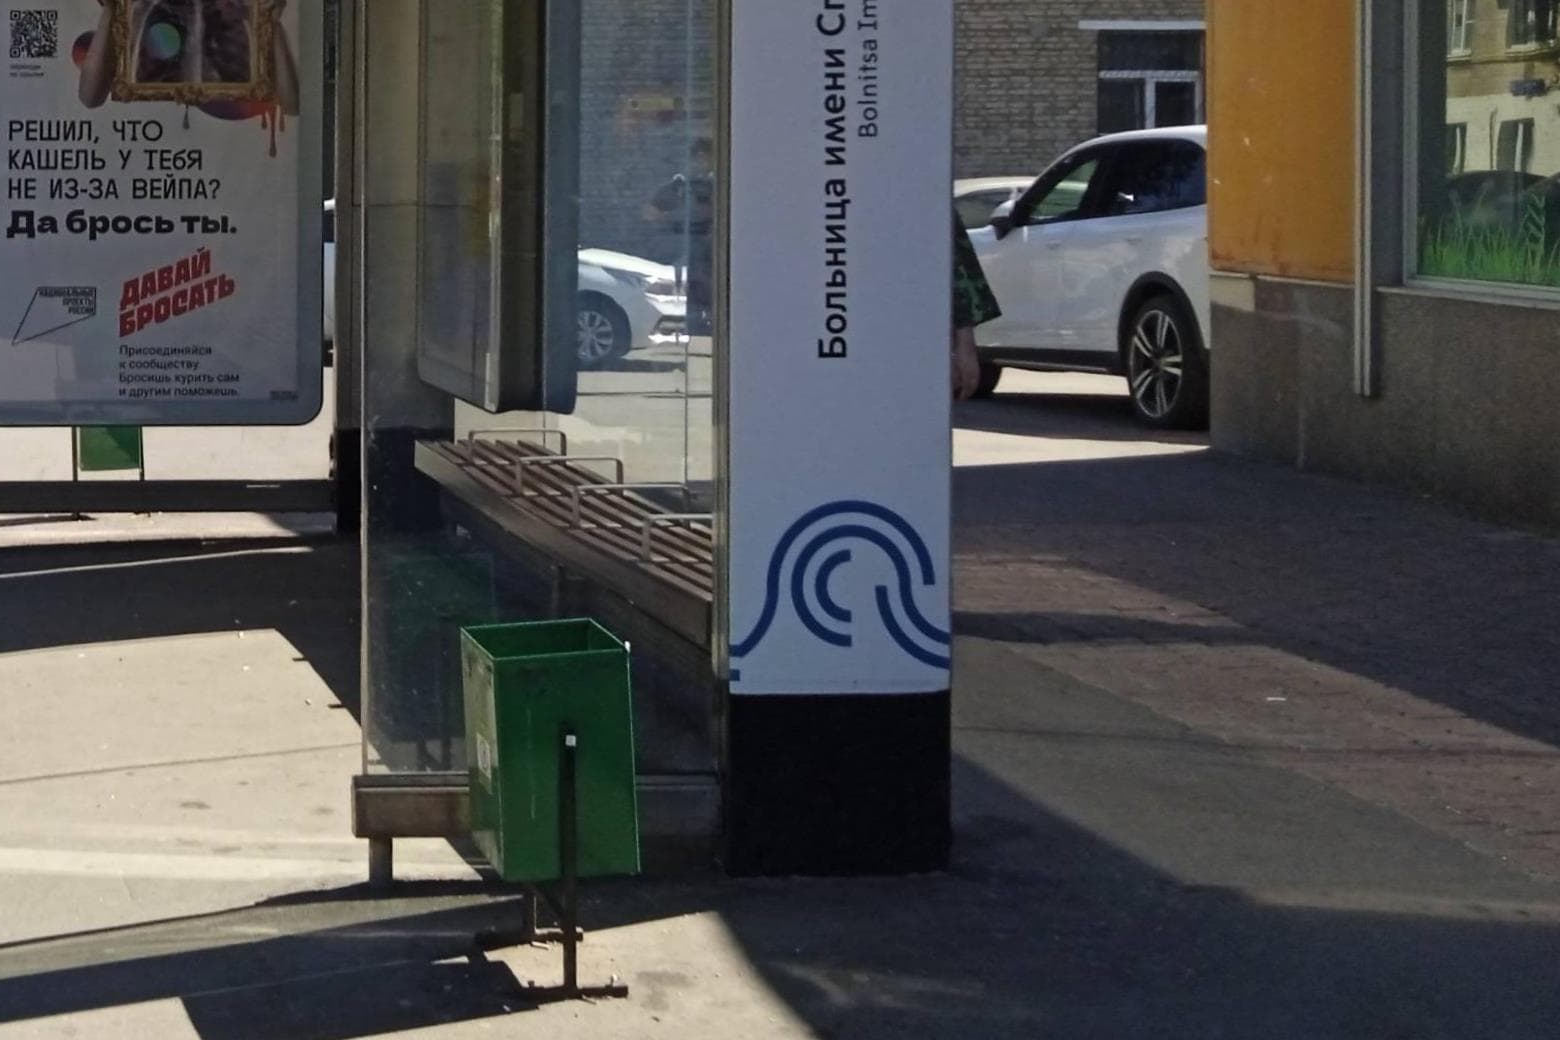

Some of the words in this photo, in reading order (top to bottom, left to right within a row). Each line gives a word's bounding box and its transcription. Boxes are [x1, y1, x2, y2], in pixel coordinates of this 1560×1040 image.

[857, 39, 878, 138] Bolnitsa
[824, 48, 846, 164] имени
[8, 119, 100, 144] РЕШИЛ,
[112, 119, 164, 142] ЧТО
[8, 148, 106, 171] КАШЕЛЬ
[118, 149, 132, 171] У
[8, 178, 37, 200] НЕ
[49, 178, 119, 200] ИЗ-ЗА
[132, 173, 221, 200] ВЕЙПА?
[6, 210, 59, 239] Да
[65, 209, 175, 241] брось
[180, 215, 237, 235] ты.
[120, 246, 211, 311] ДАВАЙ
[817, 179, 851, 360] Больница
[119, 273, 235, 338] БРОСАТЬ
[119, 344, 213, 357] Присоединяйся
[128, 359, 200, 371] сообществу
[119, 373, 172, 384] Бросишь
[174, 374, 215, 385] курить
[216, 374, 240, 383] сам
[128, 388, 171, 399] другим
